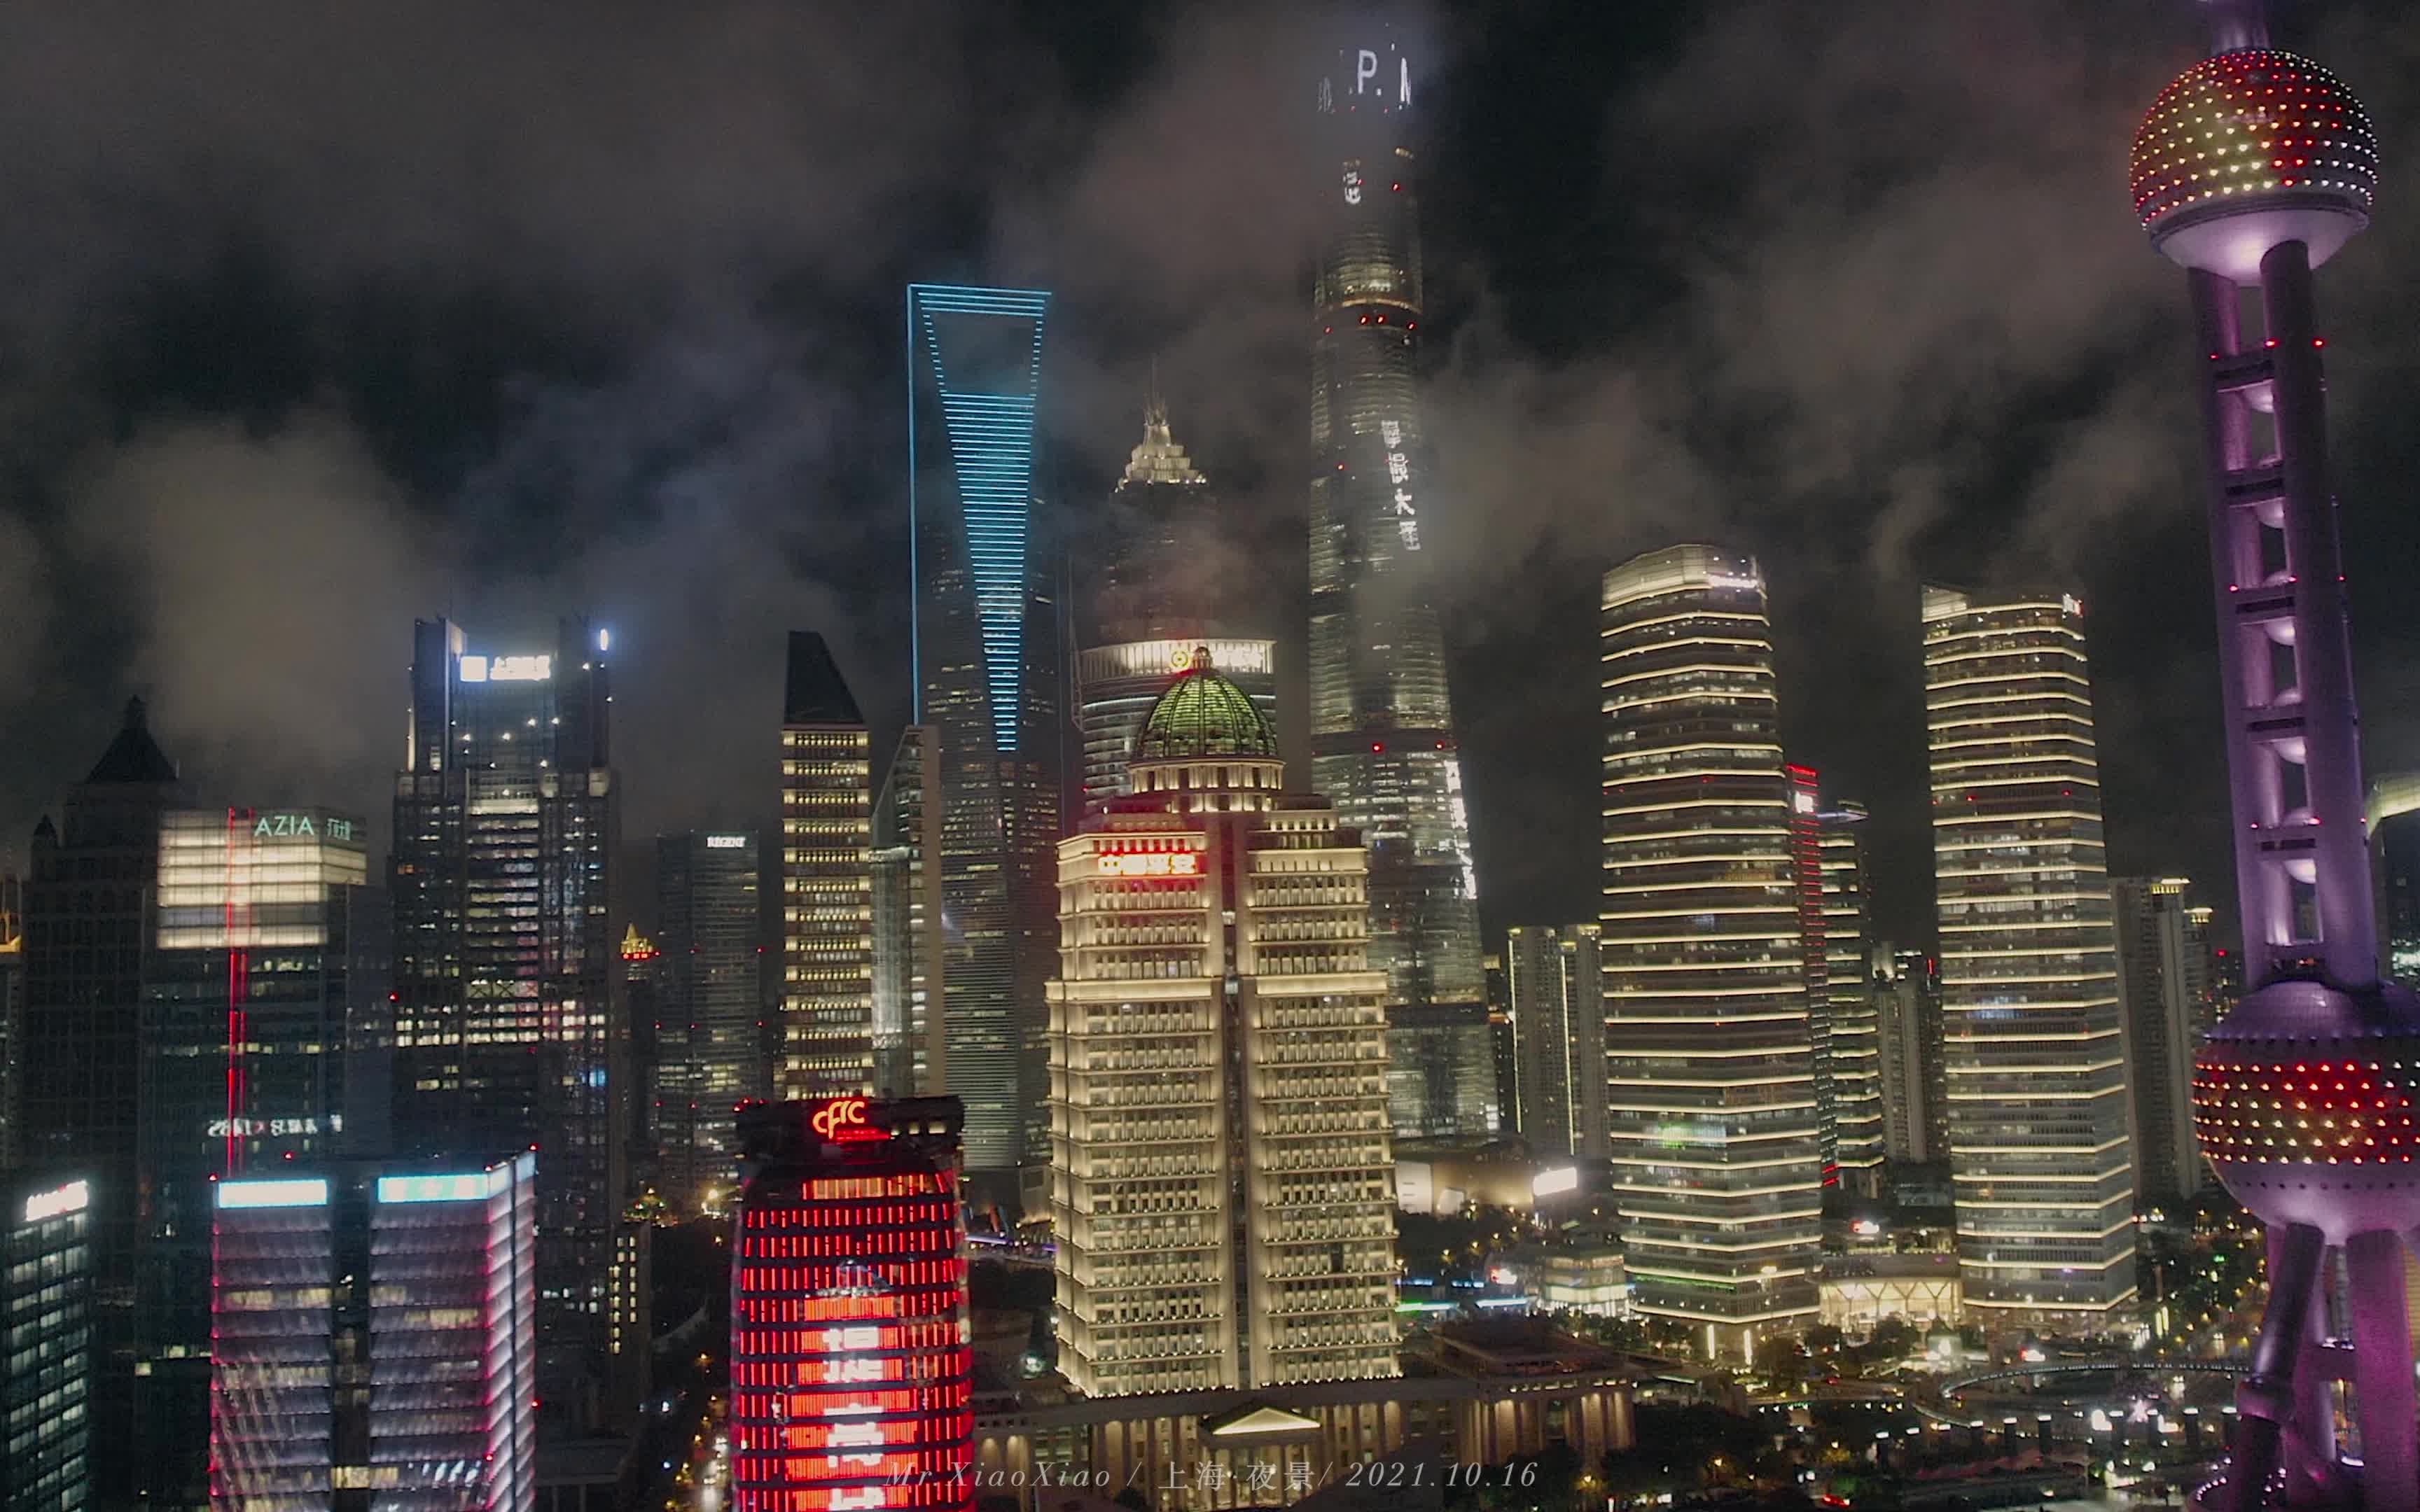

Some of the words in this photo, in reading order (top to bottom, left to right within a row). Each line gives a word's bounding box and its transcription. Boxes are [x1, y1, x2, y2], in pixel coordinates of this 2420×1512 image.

[253, 815, 314, 837] AZIA
[1097, 853, 1195, 876] 中平安
